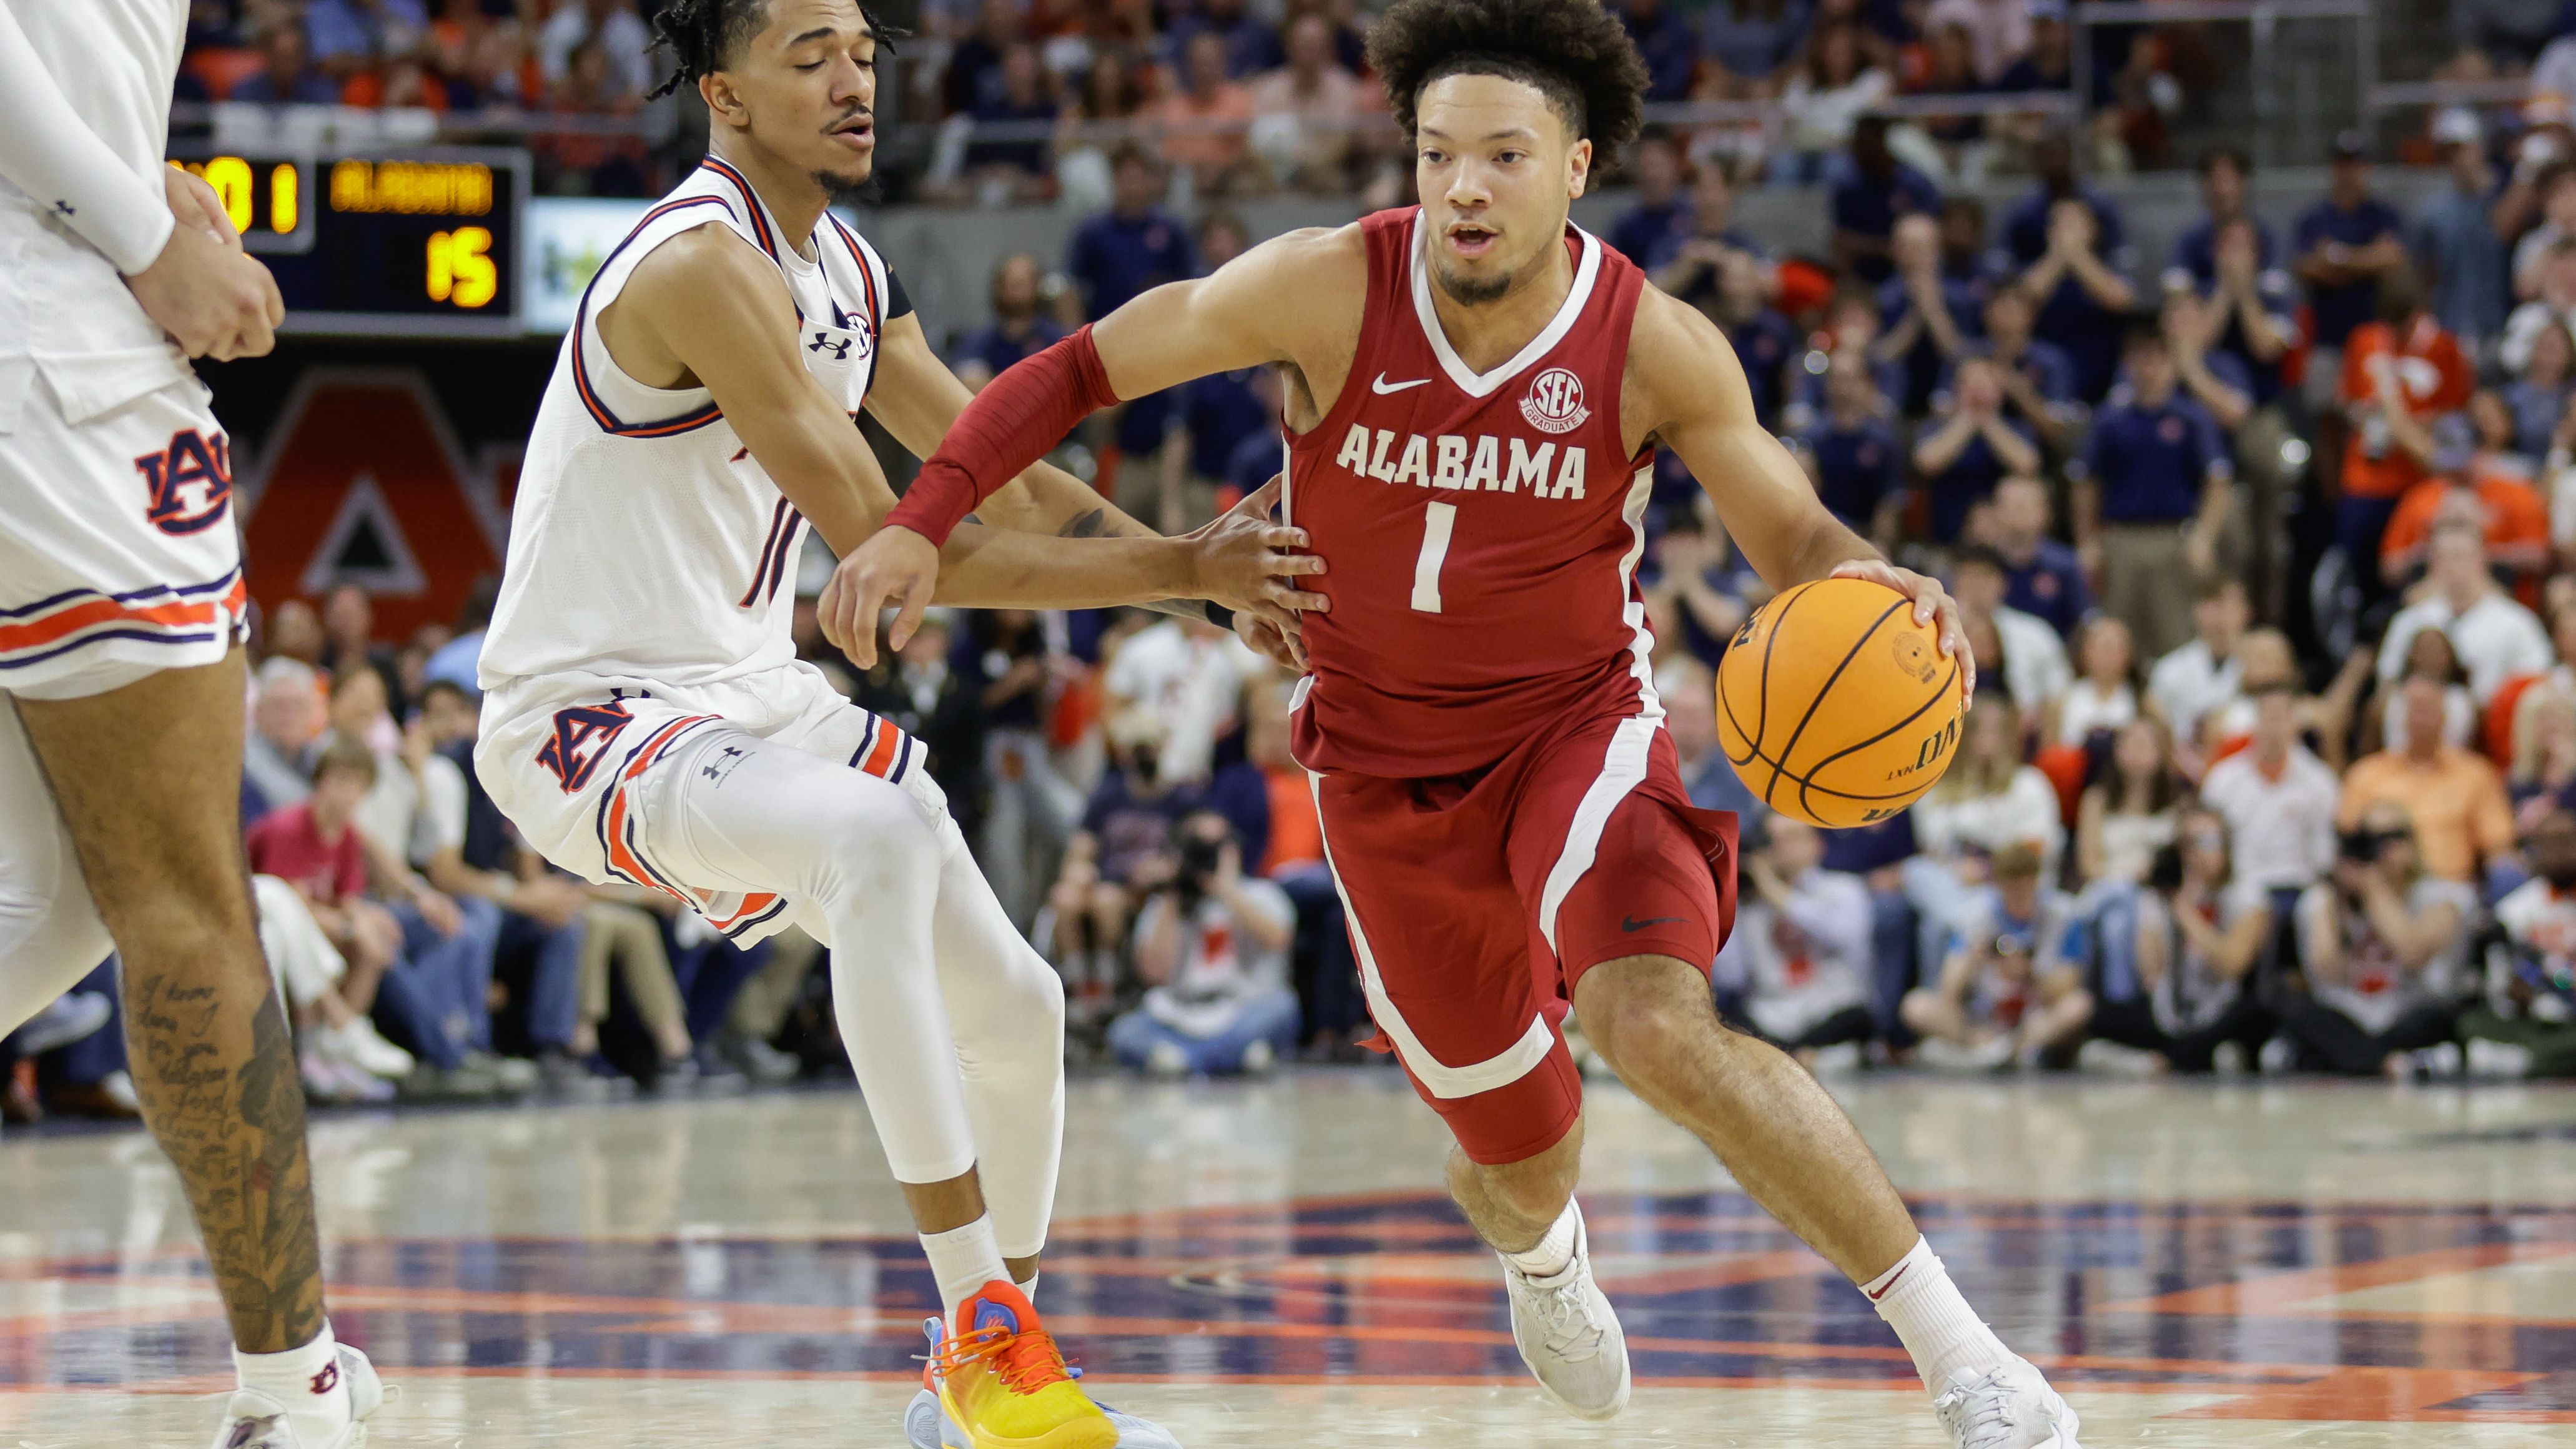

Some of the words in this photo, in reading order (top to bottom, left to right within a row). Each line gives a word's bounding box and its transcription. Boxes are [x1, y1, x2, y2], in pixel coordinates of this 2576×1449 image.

[427, 226, 496, 307] 15
[1525, 409, 1579, 432] GRADUATE
[1535, 372, 1579, 417] SEC
[1336, 423, 1586, 500] ALABAMA
[1411, 500, 1457, 613] 1
